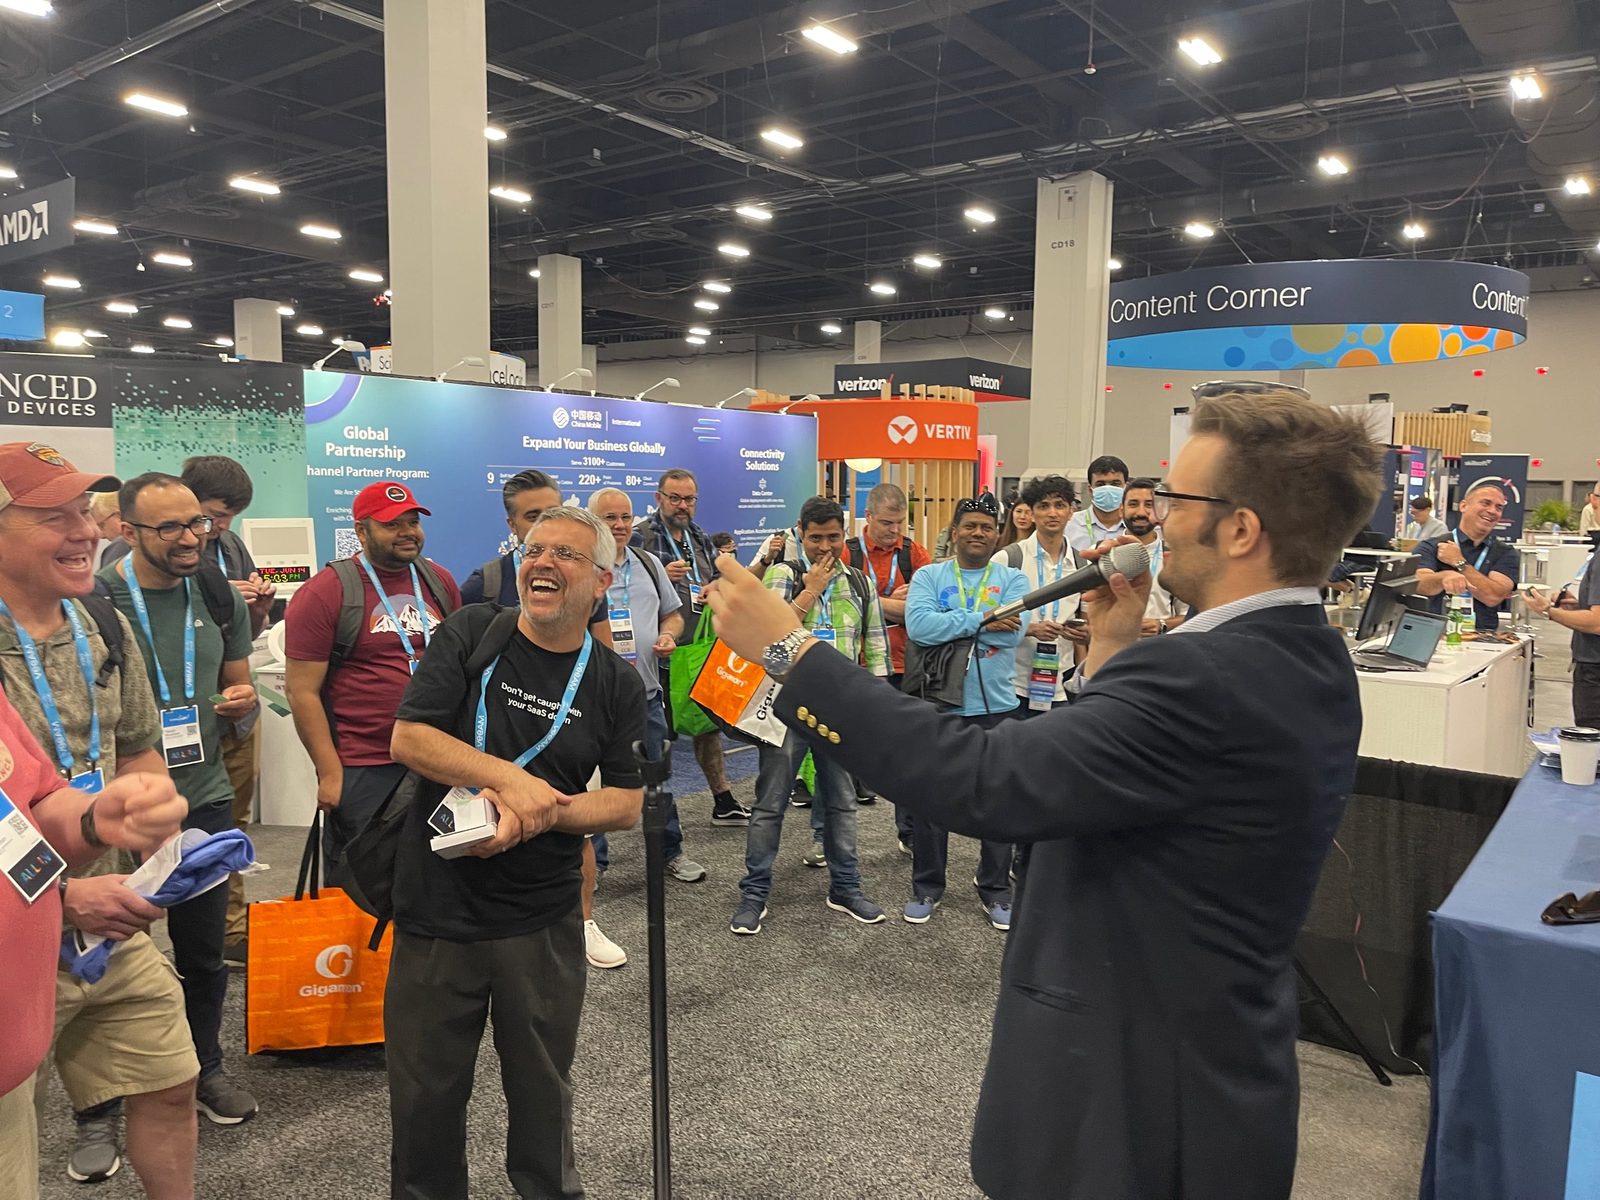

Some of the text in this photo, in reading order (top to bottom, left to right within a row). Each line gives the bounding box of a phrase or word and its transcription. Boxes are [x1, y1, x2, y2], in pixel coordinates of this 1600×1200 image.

[1051, 240, 1075, 249] CD18
[4, 305, 14, 318] 2
[1110, 285, 1313, 324] Content Corner
[969, 373, 1000, 391] verizon
[8, 401, 96, 416] DEVICES
[343, 425, 389, 441] Global
[924, 423, 971, 440] VERTIV
[325, 442, 407, 461] Partnership
[522, 435, 666, 456] Expand Your Business Globally
[740, 447, 785, 461] Connectivity
[582, 456, 606, 467] 3100+
[745, 460, 780, 471] Solutions
[346, 466, 383, 478] Partner
[385, 467, 430, 480] Program:
[487, 472, 495, 484] 9
[578, 474, 602, 486] 220+
[625, 474, 643, 486] 80+
[263, 574, 288, 583] 5:03
[500, 681, 523, 698] Don't
[522, 692, 537, 705] get
[536, 696, 563, 711] caugh
[507, 697, 571, 725] your SaaS don
